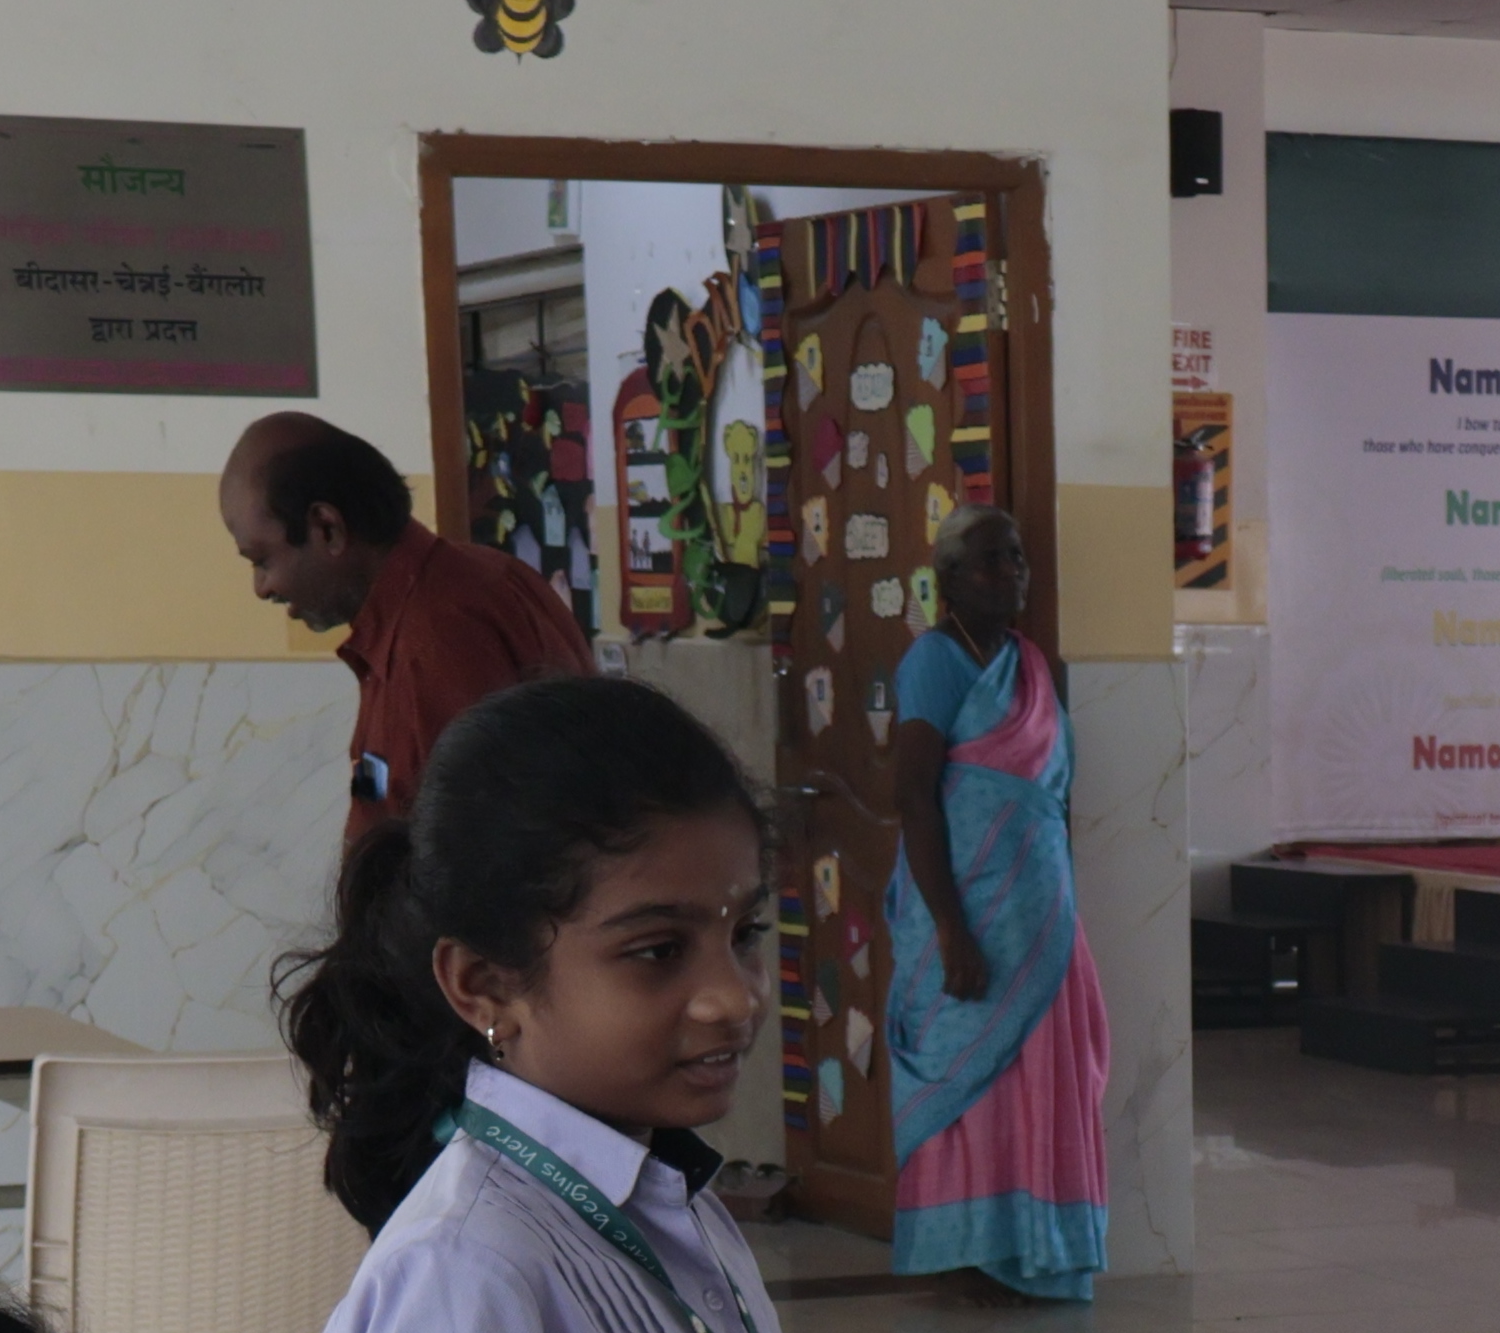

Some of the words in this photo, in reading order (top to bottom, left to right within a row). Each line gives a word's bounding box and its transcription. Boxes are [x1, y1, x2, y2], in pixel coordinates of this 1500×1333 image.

[1172, 328, 1212, 349] FIRE
[1171, 354, 1212, 373] EXIT
[485, 1125, 538, 1167] here
[540, 1160, 611, 1231] begins
